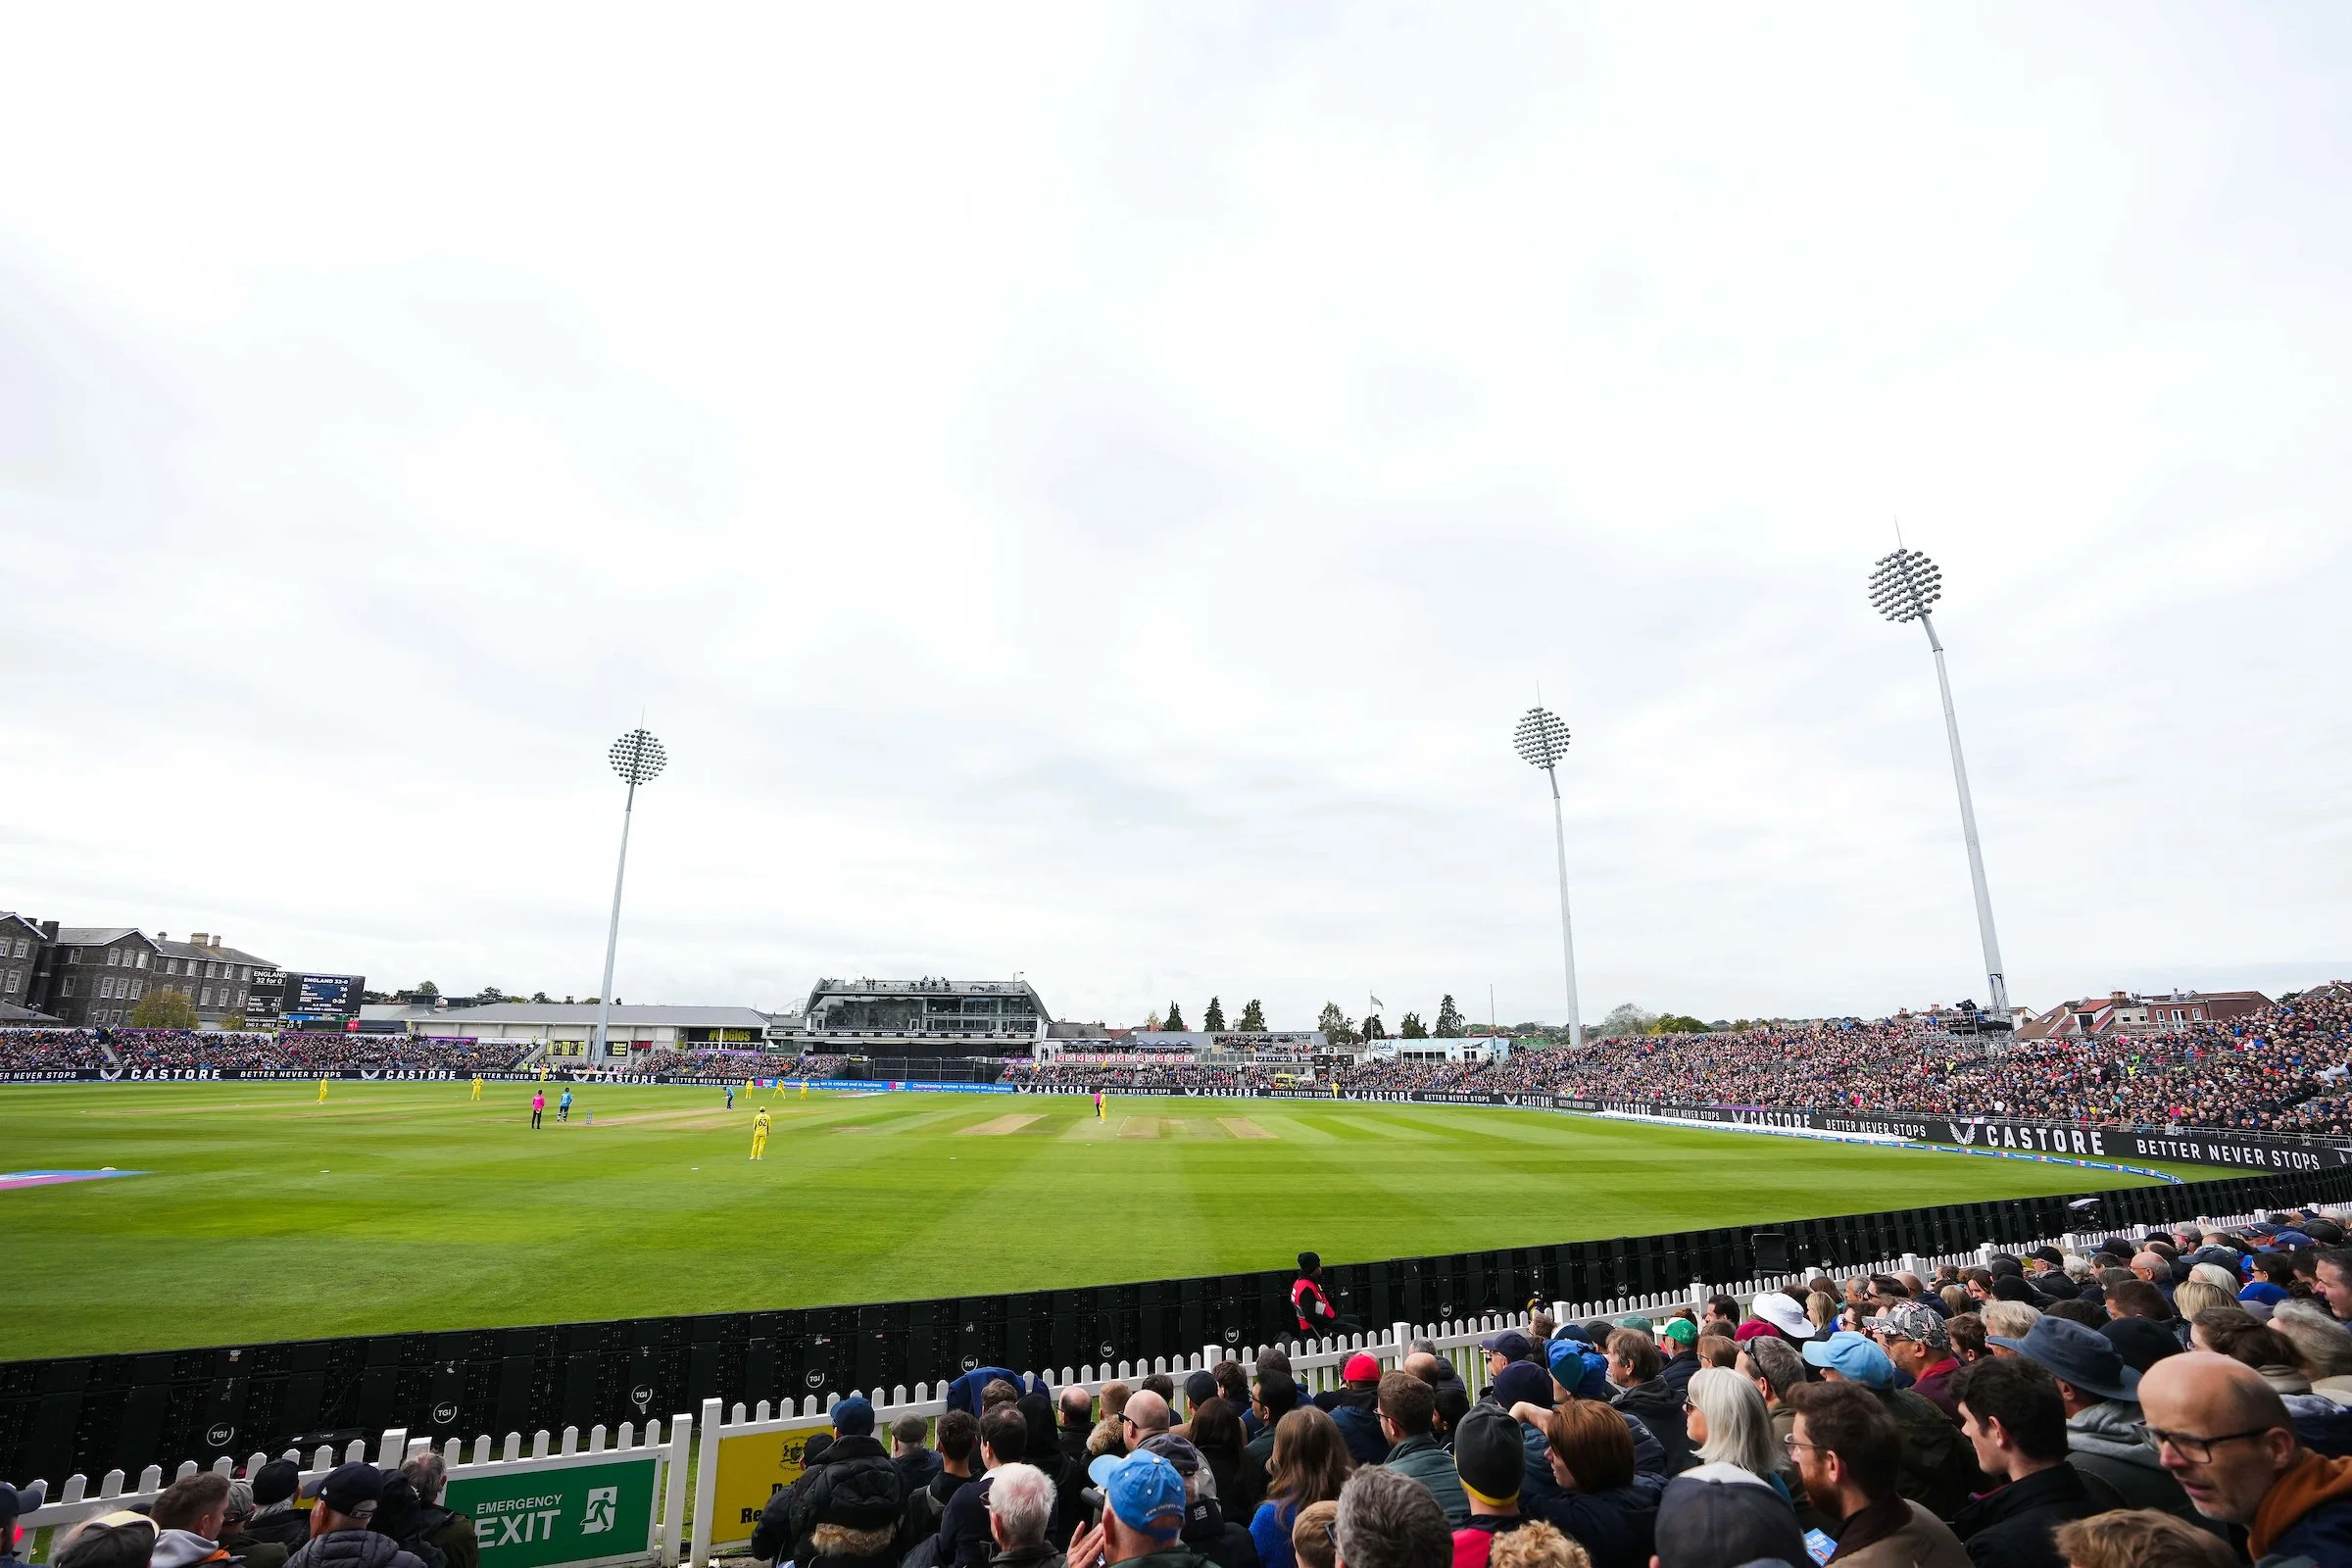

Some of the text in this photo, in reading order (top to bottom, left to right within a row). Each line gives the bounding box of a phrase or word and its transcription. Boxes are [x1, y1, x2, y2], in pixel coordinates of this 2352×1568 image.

[131, 1069, 221, 1079] CASTORE
[386, 1070, 456, 1079] CASTORE
[595, 1075, 656, 1084] CASTORE
[1036, 1085, 1090, 1094] CASTORE
[1204, 1088, 1258, 1097] CASTORE
[1362, 1091, 1412, 1101] CASTORE
[1522, 1095, 1553, 1108] CASTORE
[1614, 1102, 1651, 1115] CASTORE
[1661, 1108, 1720, 1121] BETTER NEVER STOPS
[1751, 1111, 1810, 1129] CASTORE
[1825, 1119, 1926, 1137] BETTER NEVER STOPS
[1986, 1125, 2105, 1156] CASTORE
[2136, 1139, 2320, 1170] BETTER NEVER STOPS
[476, 1494, 563, 1514] EMERGENCY
[474, 1509, 561, 1549] EXIT
